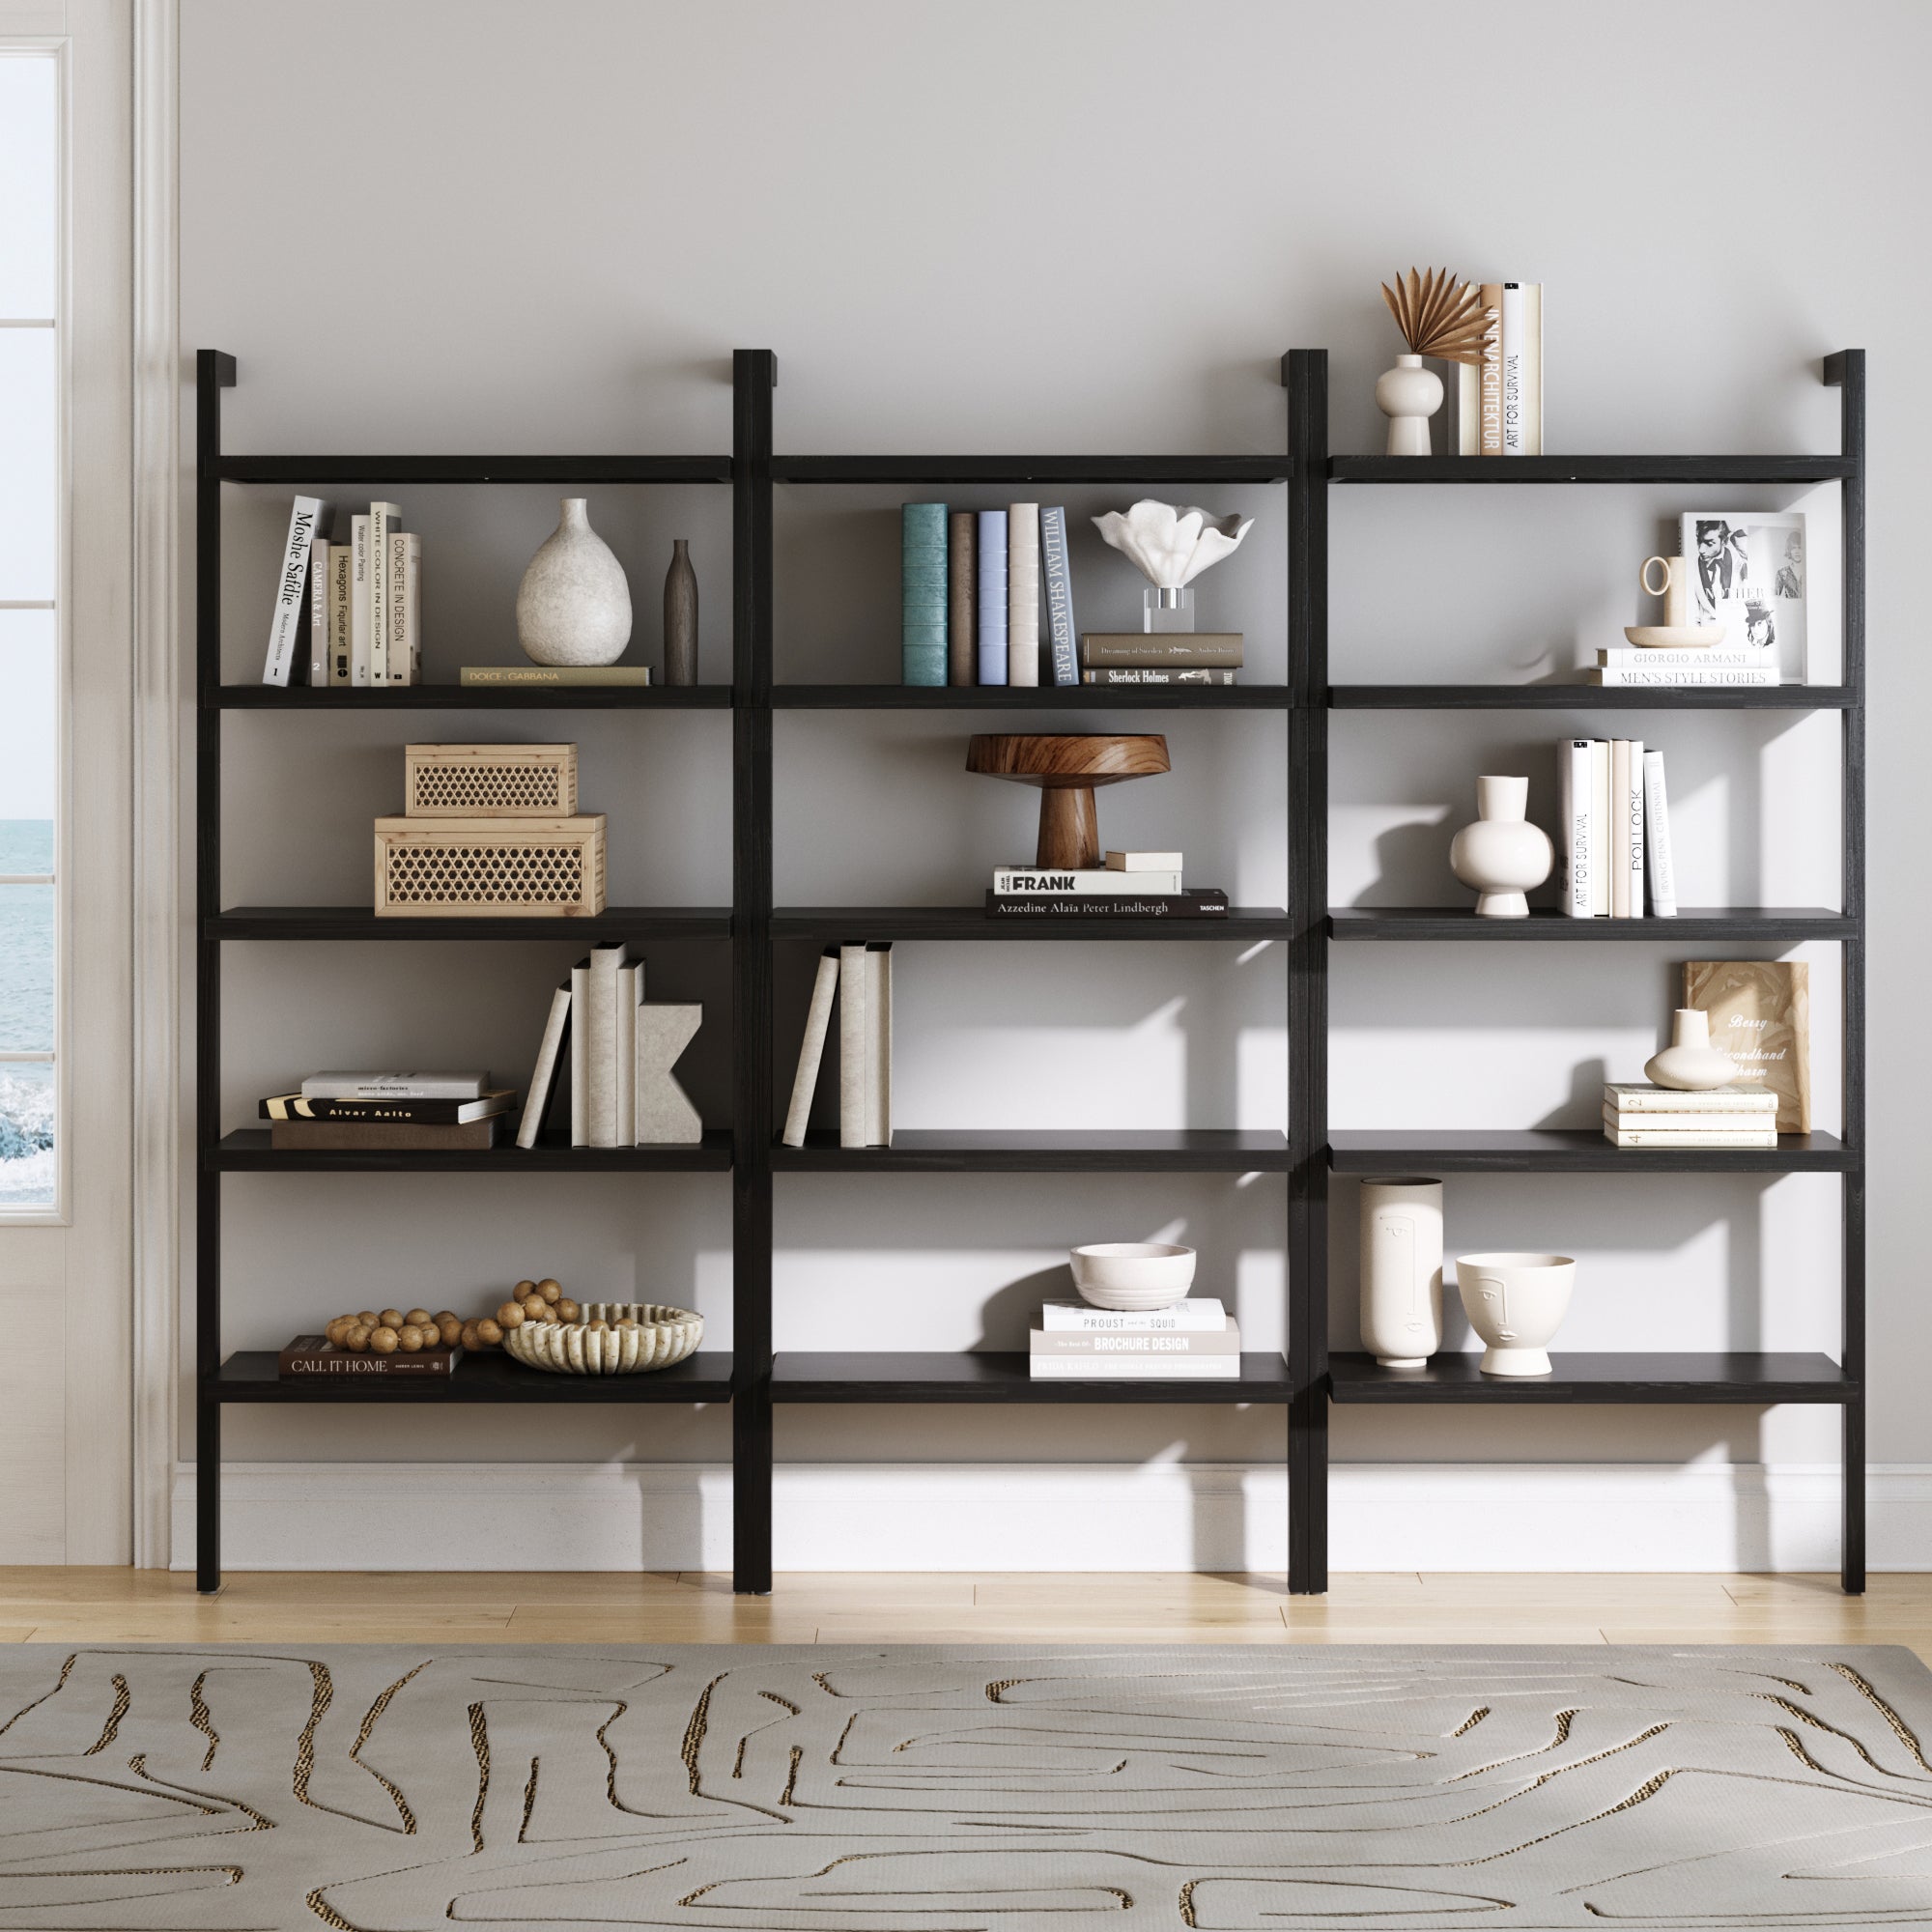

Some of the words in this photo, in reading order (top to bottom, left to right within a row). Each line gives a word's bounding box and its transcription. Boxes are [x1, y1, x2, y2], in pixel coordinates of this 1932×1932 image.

[1506, 355, 1519, 401] SURVIVAL
[1506, 404, 1519, 425] FOR
[1506, 428, 1519, 448] ART
[290, 510, 314, 559] Moshe
[1043, 510, 1065, 579] WILLIAM
[394, 539, 405, 591] CONCRETE
[281, 562, 304, 606] Safdie
[313, 561, 323, 601] CAMERA
[337, 555, 349, 602] Hexagons
[374, 592, 382, 604] IN
[394, 594, 405, 604] IN
[313, 612, 323, 626] Art
[394, 606, 405, 641] DESIGN
[1049, 582, 1072, 682] SHAKESPEARE
[338, 636, 347, 647] art
[1634, 653, 1689, 664] GIORGIO
[1693, 653, 1747, 664] ARMANI
[273, 668, 278, 676] 1
[313, 663, 321, 671] 2
[507, 672, 559, 681] GABBANA
[1108, 670, 1140, 683] Sherlock
[1142, 670, 1169, 683] Holmes
[1620, 672, 1662, 684] MEN'S
[1664, 672, 1707, 684] STYLE
[1710, 672, 1766, 684] STORIES
[1576, 813, 1587, 860] SURVIVAL
[1576, 863, 1587, 885] FOR
[1012, 876, 1075, 891] FRANK
[1576, 889, 1587, 906] ART
[997, 903, 1047, 913] Azzedine
[1050, 902, 1079, 913] Alaïa
[1083, 902, 1110, 913] Peter
[1113, 902, 1169, 916] Lindbergh
[1716, 1047, 1787, 1061] condhand
[1628, 1134, 1641, 1144] 4
[1083, 1319, 1124, 1328] PROUST
[1151, 1319, 1176, 1328] SQUID
[1094, 1336, 1151, 1350] BROCHURE
[1151, 1336, 1190, 1350] DESIGN
[291, 1360, 327, 1372] CALL
[329, 1360, 342, 1372] IT
[346, 1360, 388, 1372] HOME
